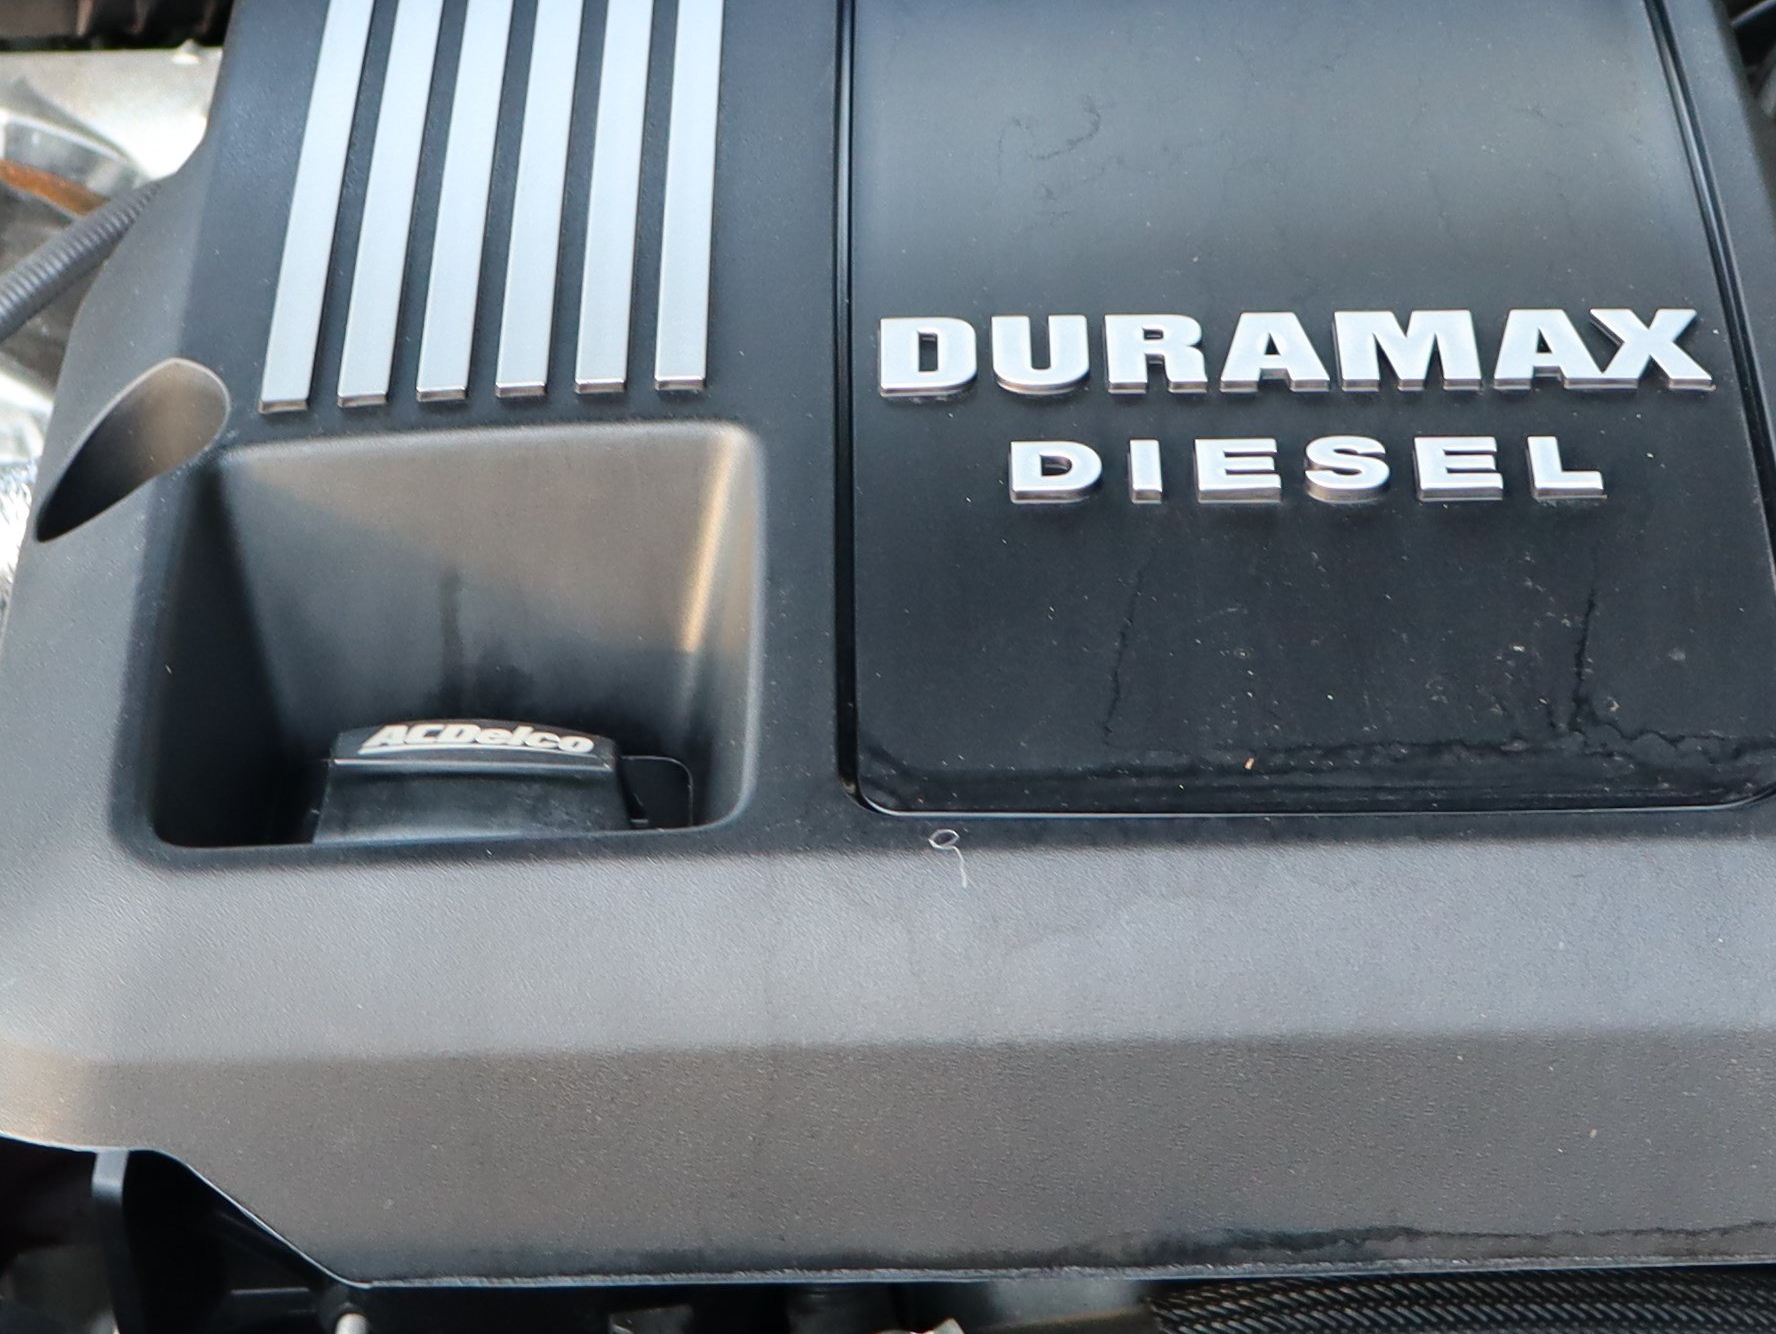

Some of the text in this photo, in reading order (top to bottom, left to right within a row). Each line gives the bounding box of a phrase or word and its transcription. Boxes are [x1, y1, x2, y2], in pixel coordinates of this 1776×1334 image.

[879, 308, 1716, 396] DURAMAX
[1008, 434, 1608, 503] DIESEL
[360, 723, 595, 753] ACDelco
